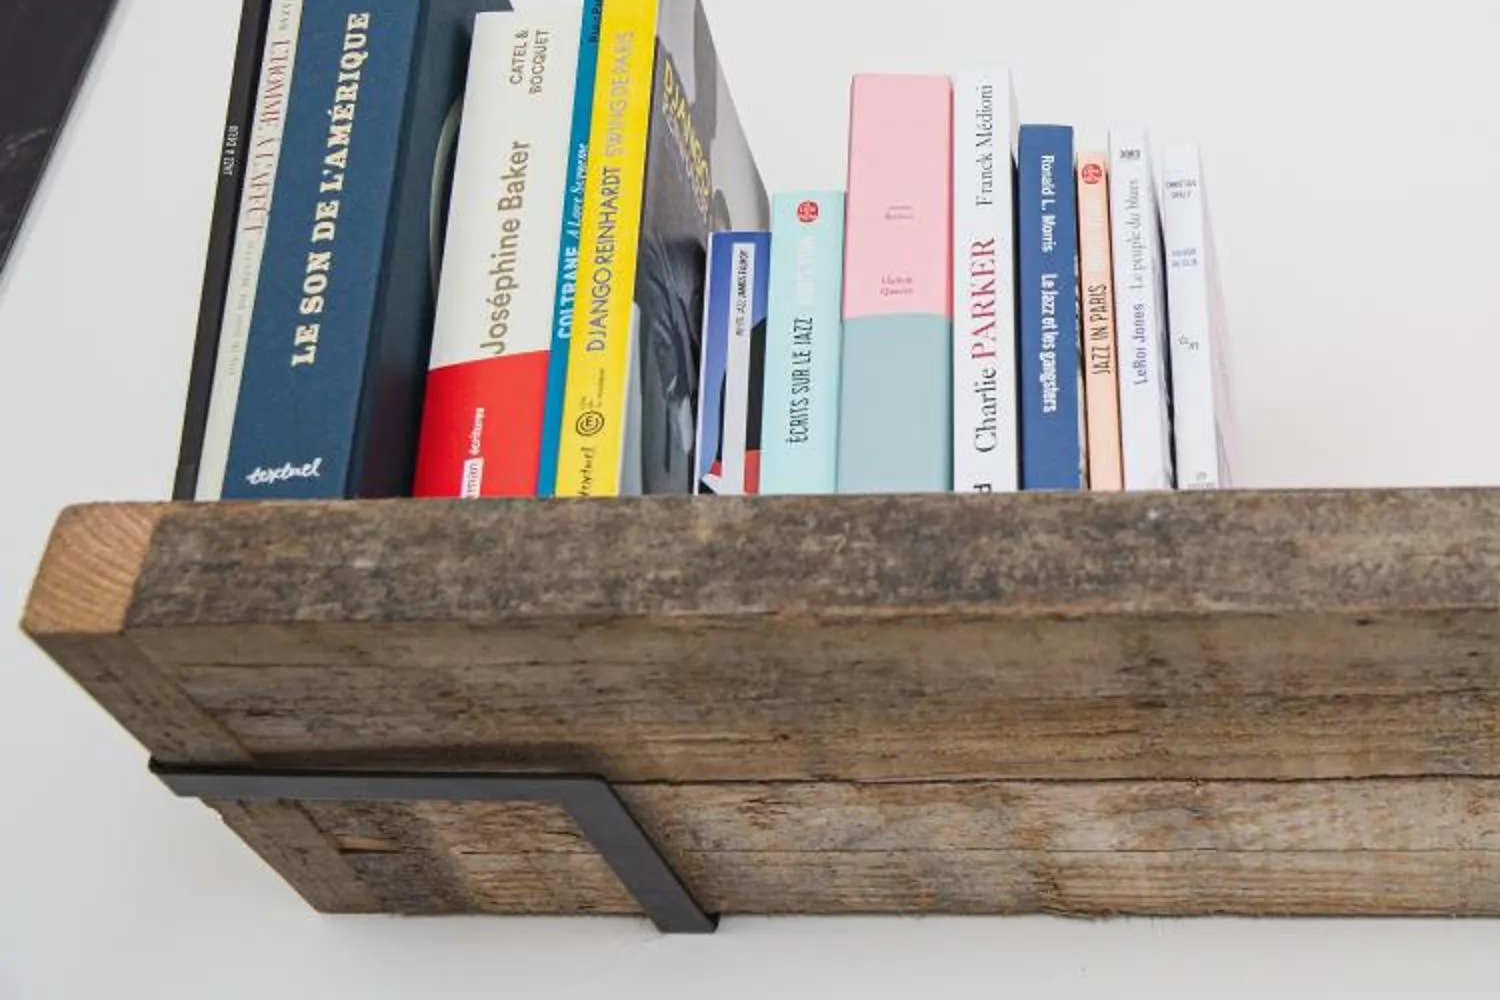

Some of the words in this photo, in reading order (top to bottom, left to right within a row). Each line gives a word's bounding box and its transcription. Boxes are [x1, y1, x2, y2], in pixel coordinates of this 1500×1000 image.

[510, 42, 527, 85] CATEL
[529, 29, 550, 95] BOCQUET
[320, 12, 371, 192] L'AMÉRIQUE
[975, 85, 993, 149] Médioni
[604, 102, 627, 157] SWING
[498, 141, 531, 211] Baker
[975, 153, 993, 206] Franck
[1041, 155, 1056, 196] Ronald
[312, 200, 340, 242] DE
[596, 167, 621, 266] REINHARDT
[1041, 215, 1056, 253] Morris
[300, 251, 331, 315] SON
[480, 219, 521, 355] Joséphine
[970, 236, 996, 360] PARKER
[1041, 273, 1059, 288] Le
[586, 268, 613, 353] DJANGO
[1041, 317, 1058, 330] et
[1088, 284, 1108, 323] PARIS
[1133, 303, 1147, 344] Jones
[291, 323, 320, 367] LE
[794, 317, 813, 347] JAZZ
[1041, 332, 1060, 350] les
[1090, 324, 1109, 342] IN
[792, 349, 811, 365] LE
[1091, 343, 1111, 375] JAZZ
[791, 367, 811, 395] SUR
[1039, 351, 1060, 413] gangsters
[786, 397, 809, 445] ÉCRITS
[973, 368, 997, 453] Charlie
